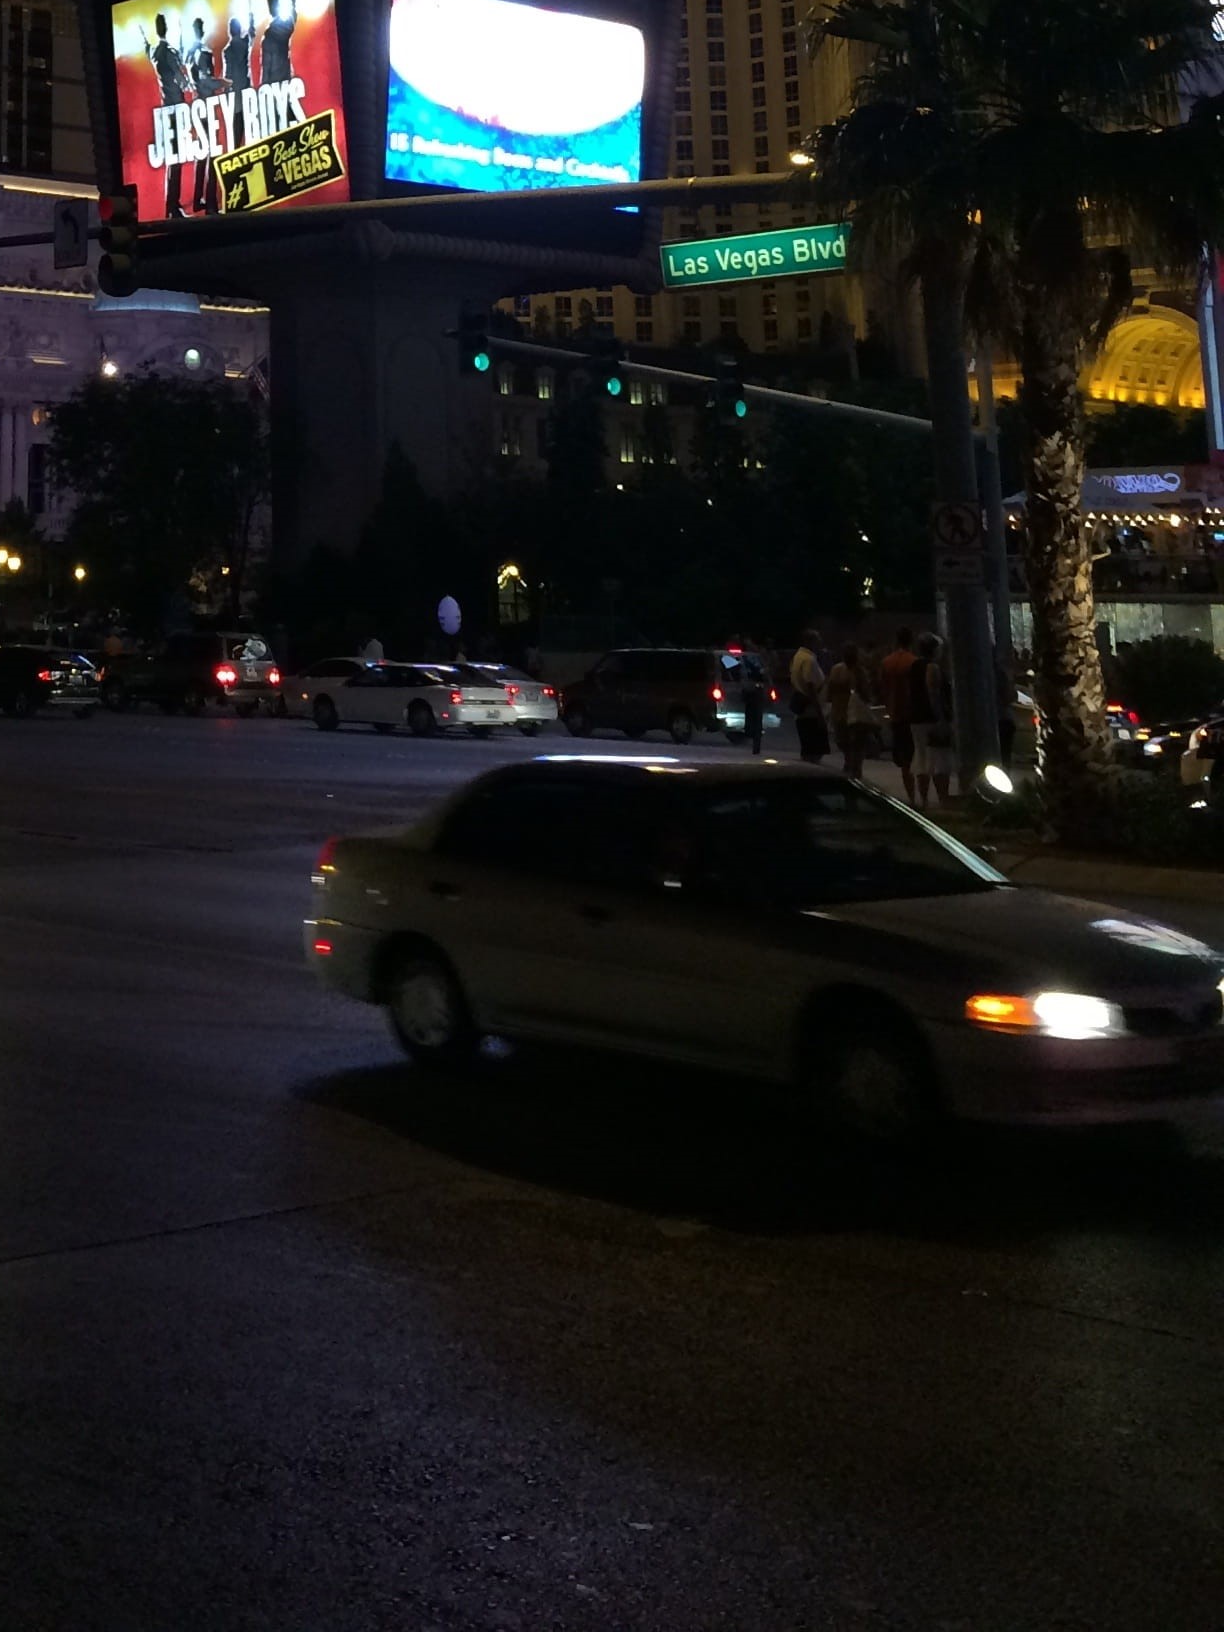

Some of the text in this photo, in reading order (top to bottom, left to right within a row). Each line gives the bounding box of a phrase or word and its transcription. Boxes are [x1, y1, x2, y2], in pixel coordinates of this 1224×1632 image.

[147, 77, 307, 169] JERSEY BOYS
[272, 123, 330, 166] Best Show
[221, 144, 271, 174] RATED
[281, 145, 332, 185] VEGAS
[668, 234, 847, 277] Las Vegas Blvd
